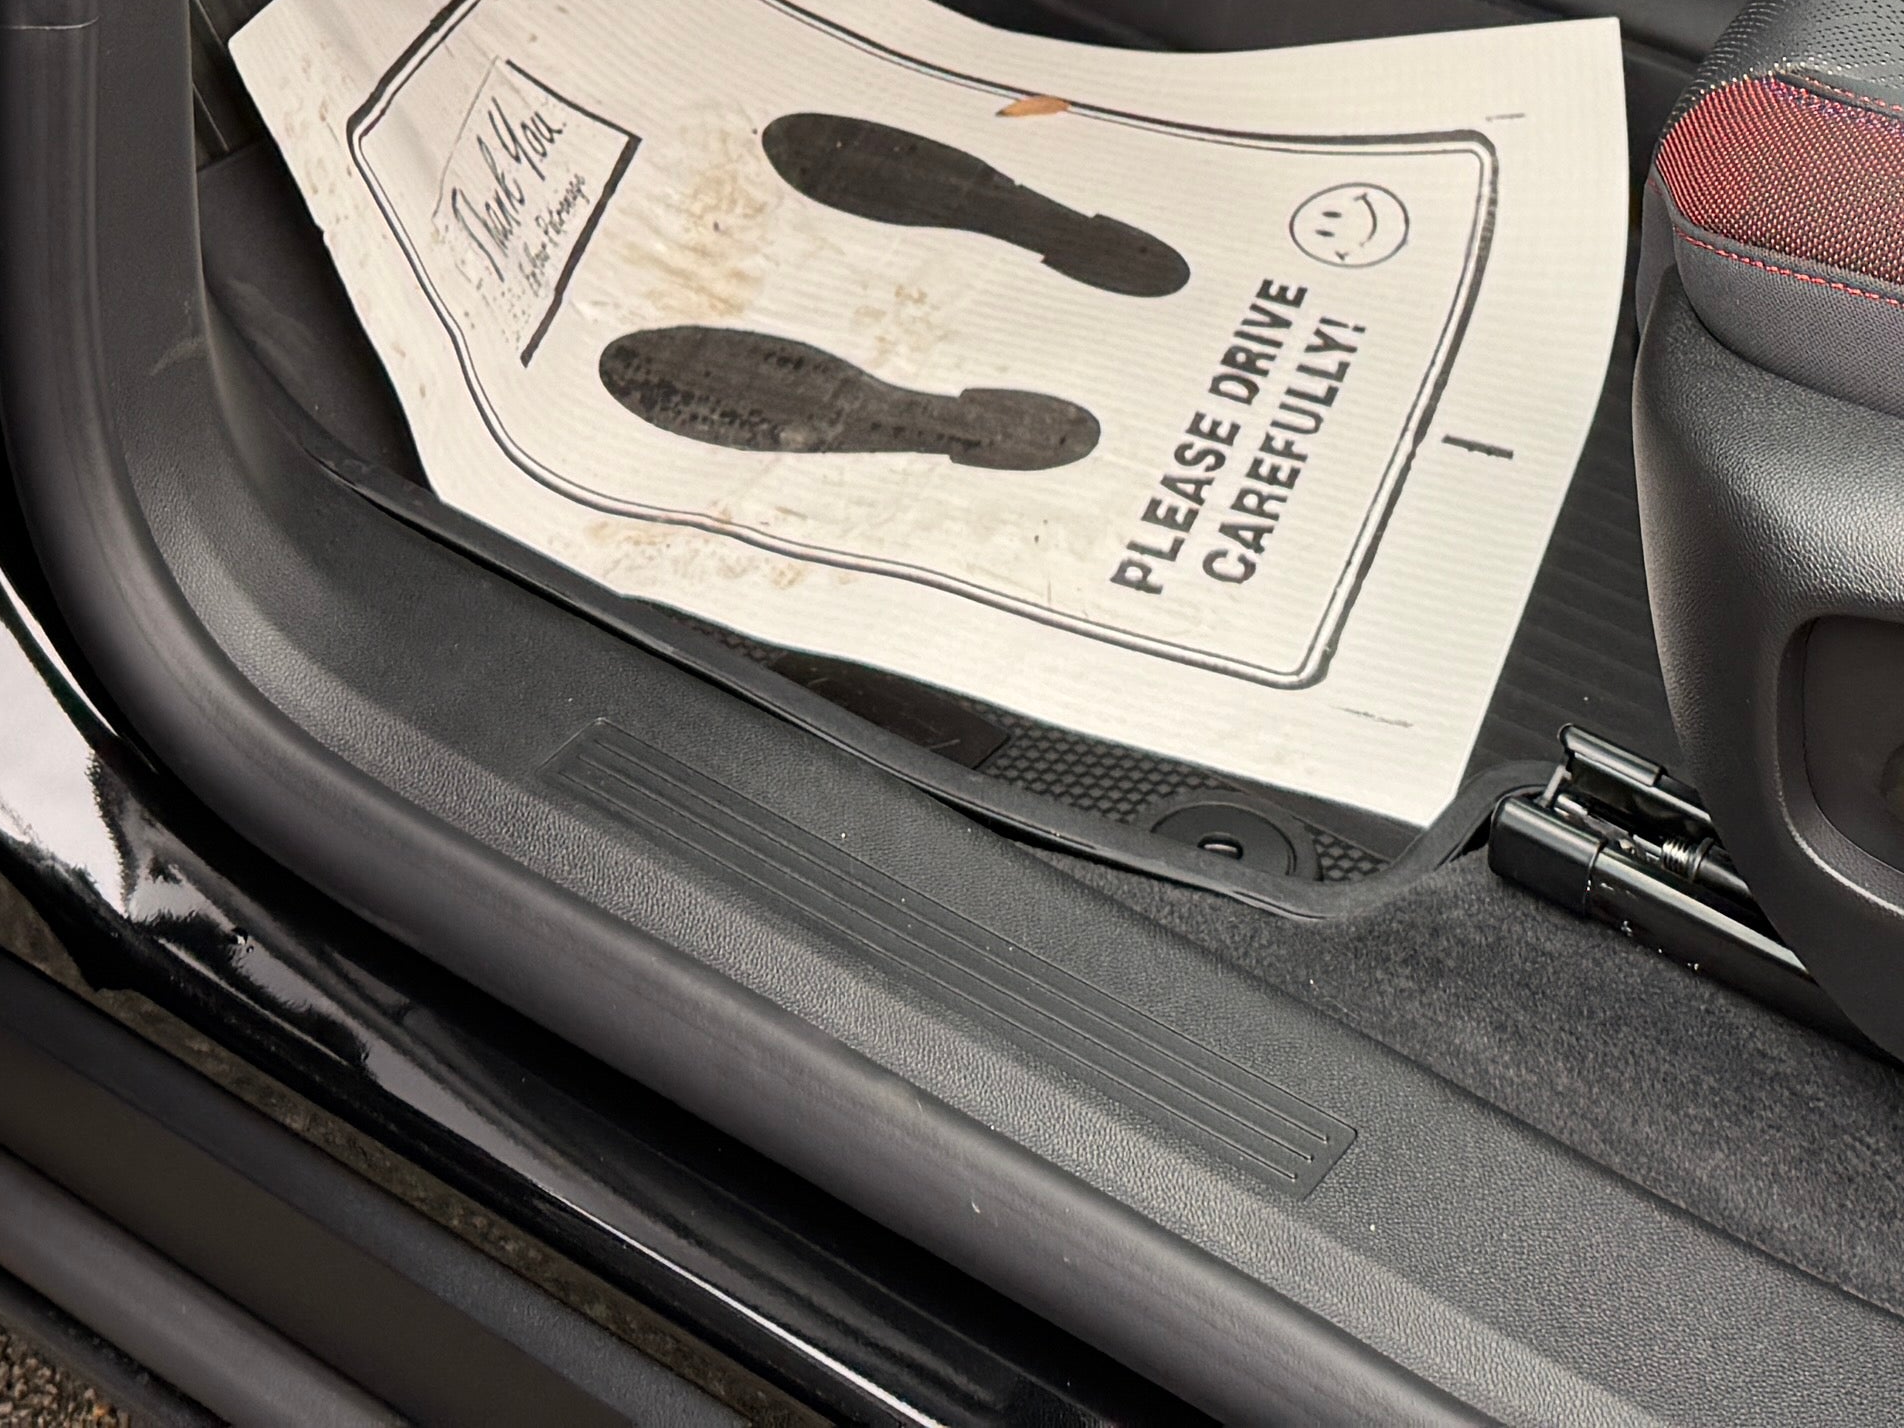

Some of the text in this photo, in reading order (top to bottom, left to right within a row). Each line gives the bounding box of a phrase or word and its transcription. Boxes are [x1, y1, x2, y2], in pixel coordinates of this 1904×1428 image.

[451, 133, 526, 283] Thank
[1109, 277, 1309, 596] PLEASE DRIVE
[1201, 315, 1367, 585] CAREFULLY!
